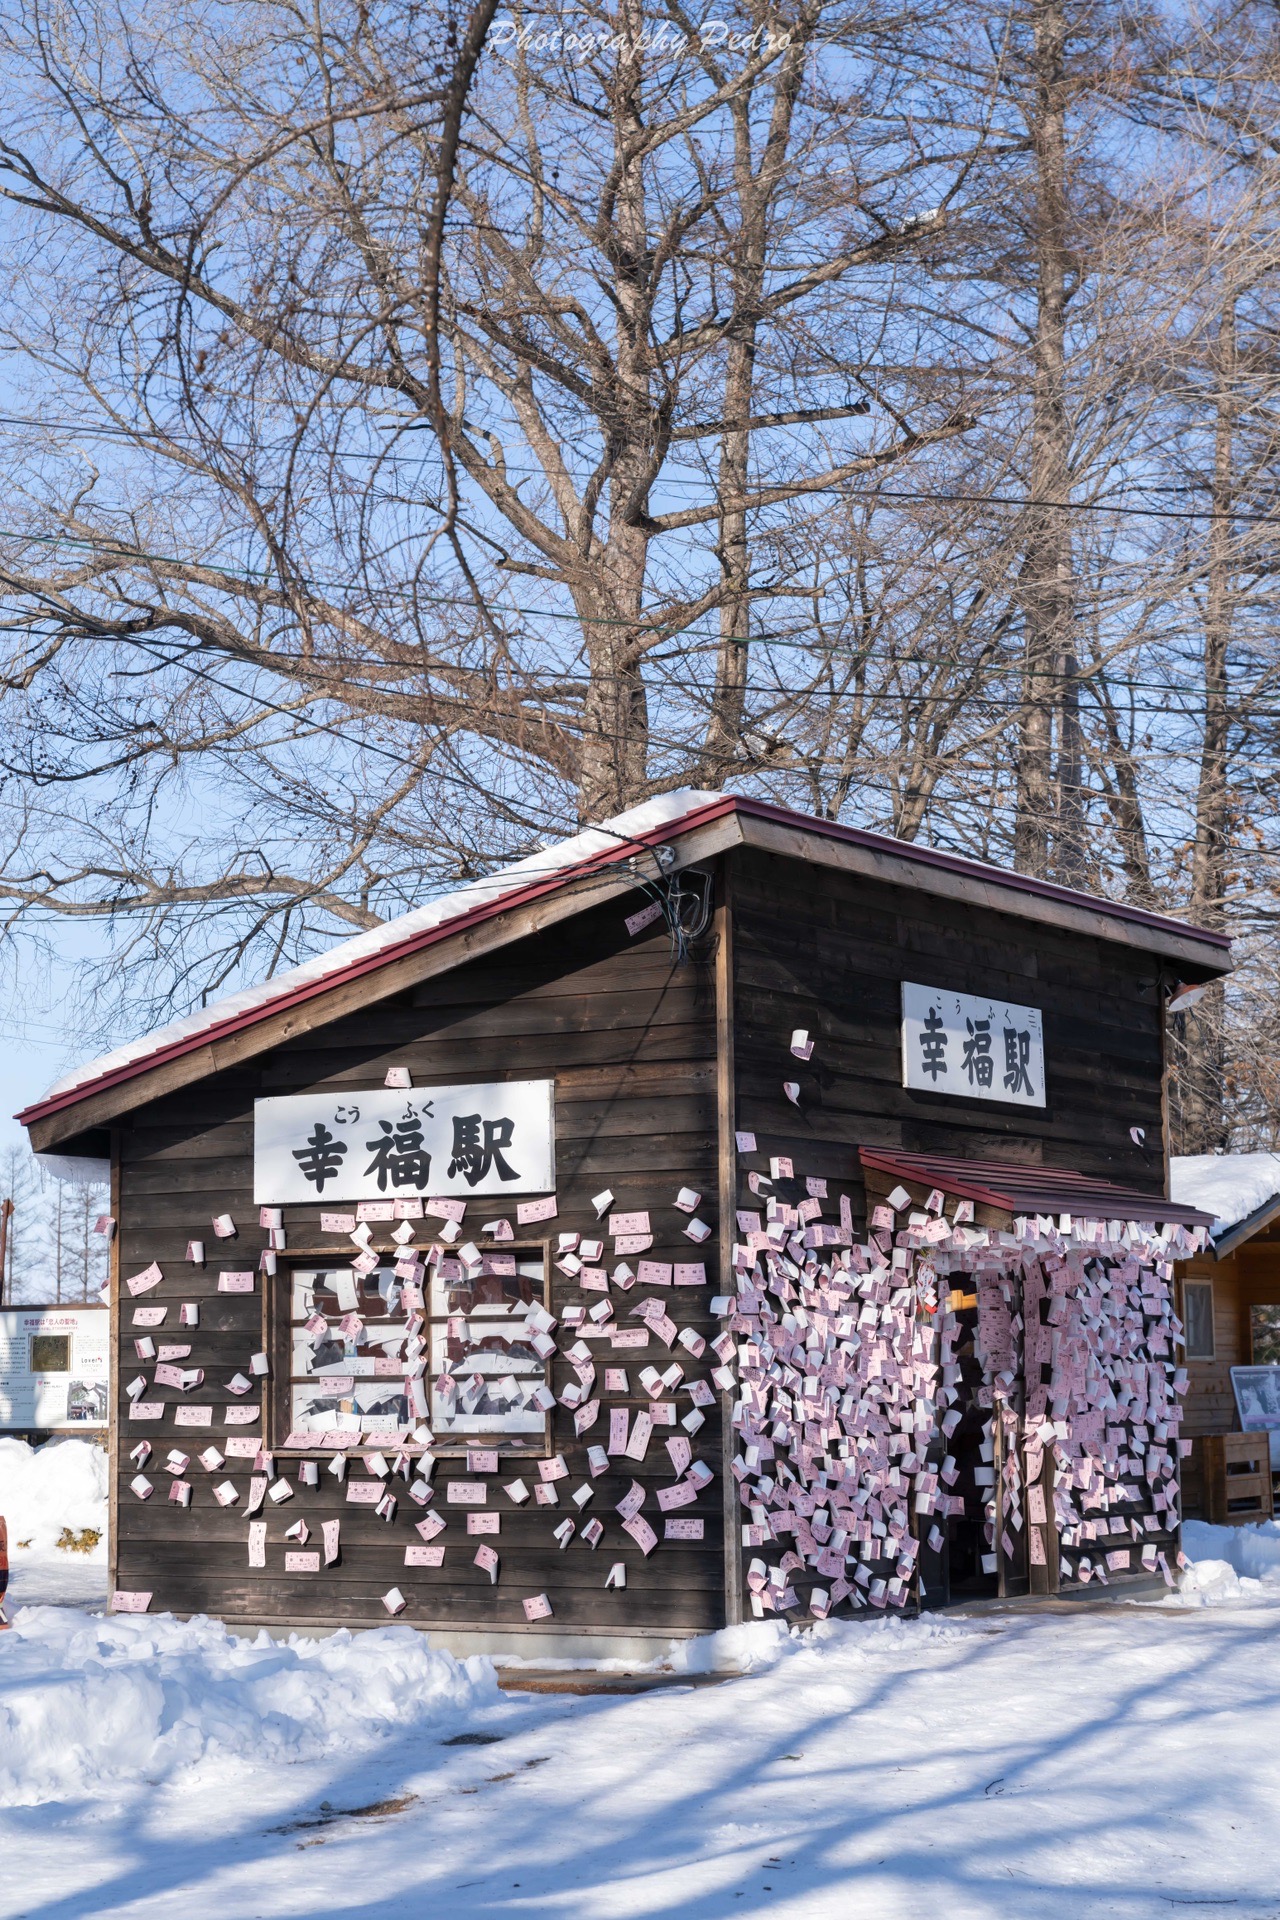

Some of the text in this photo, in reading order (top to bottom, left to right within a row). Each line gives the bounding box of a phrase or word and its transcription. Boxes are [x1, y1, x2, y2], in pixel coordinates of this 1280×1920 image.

[919, 1006, 1035, 1097] 幸福駅
[292, 1113, 522, 1194] 幸福駅
